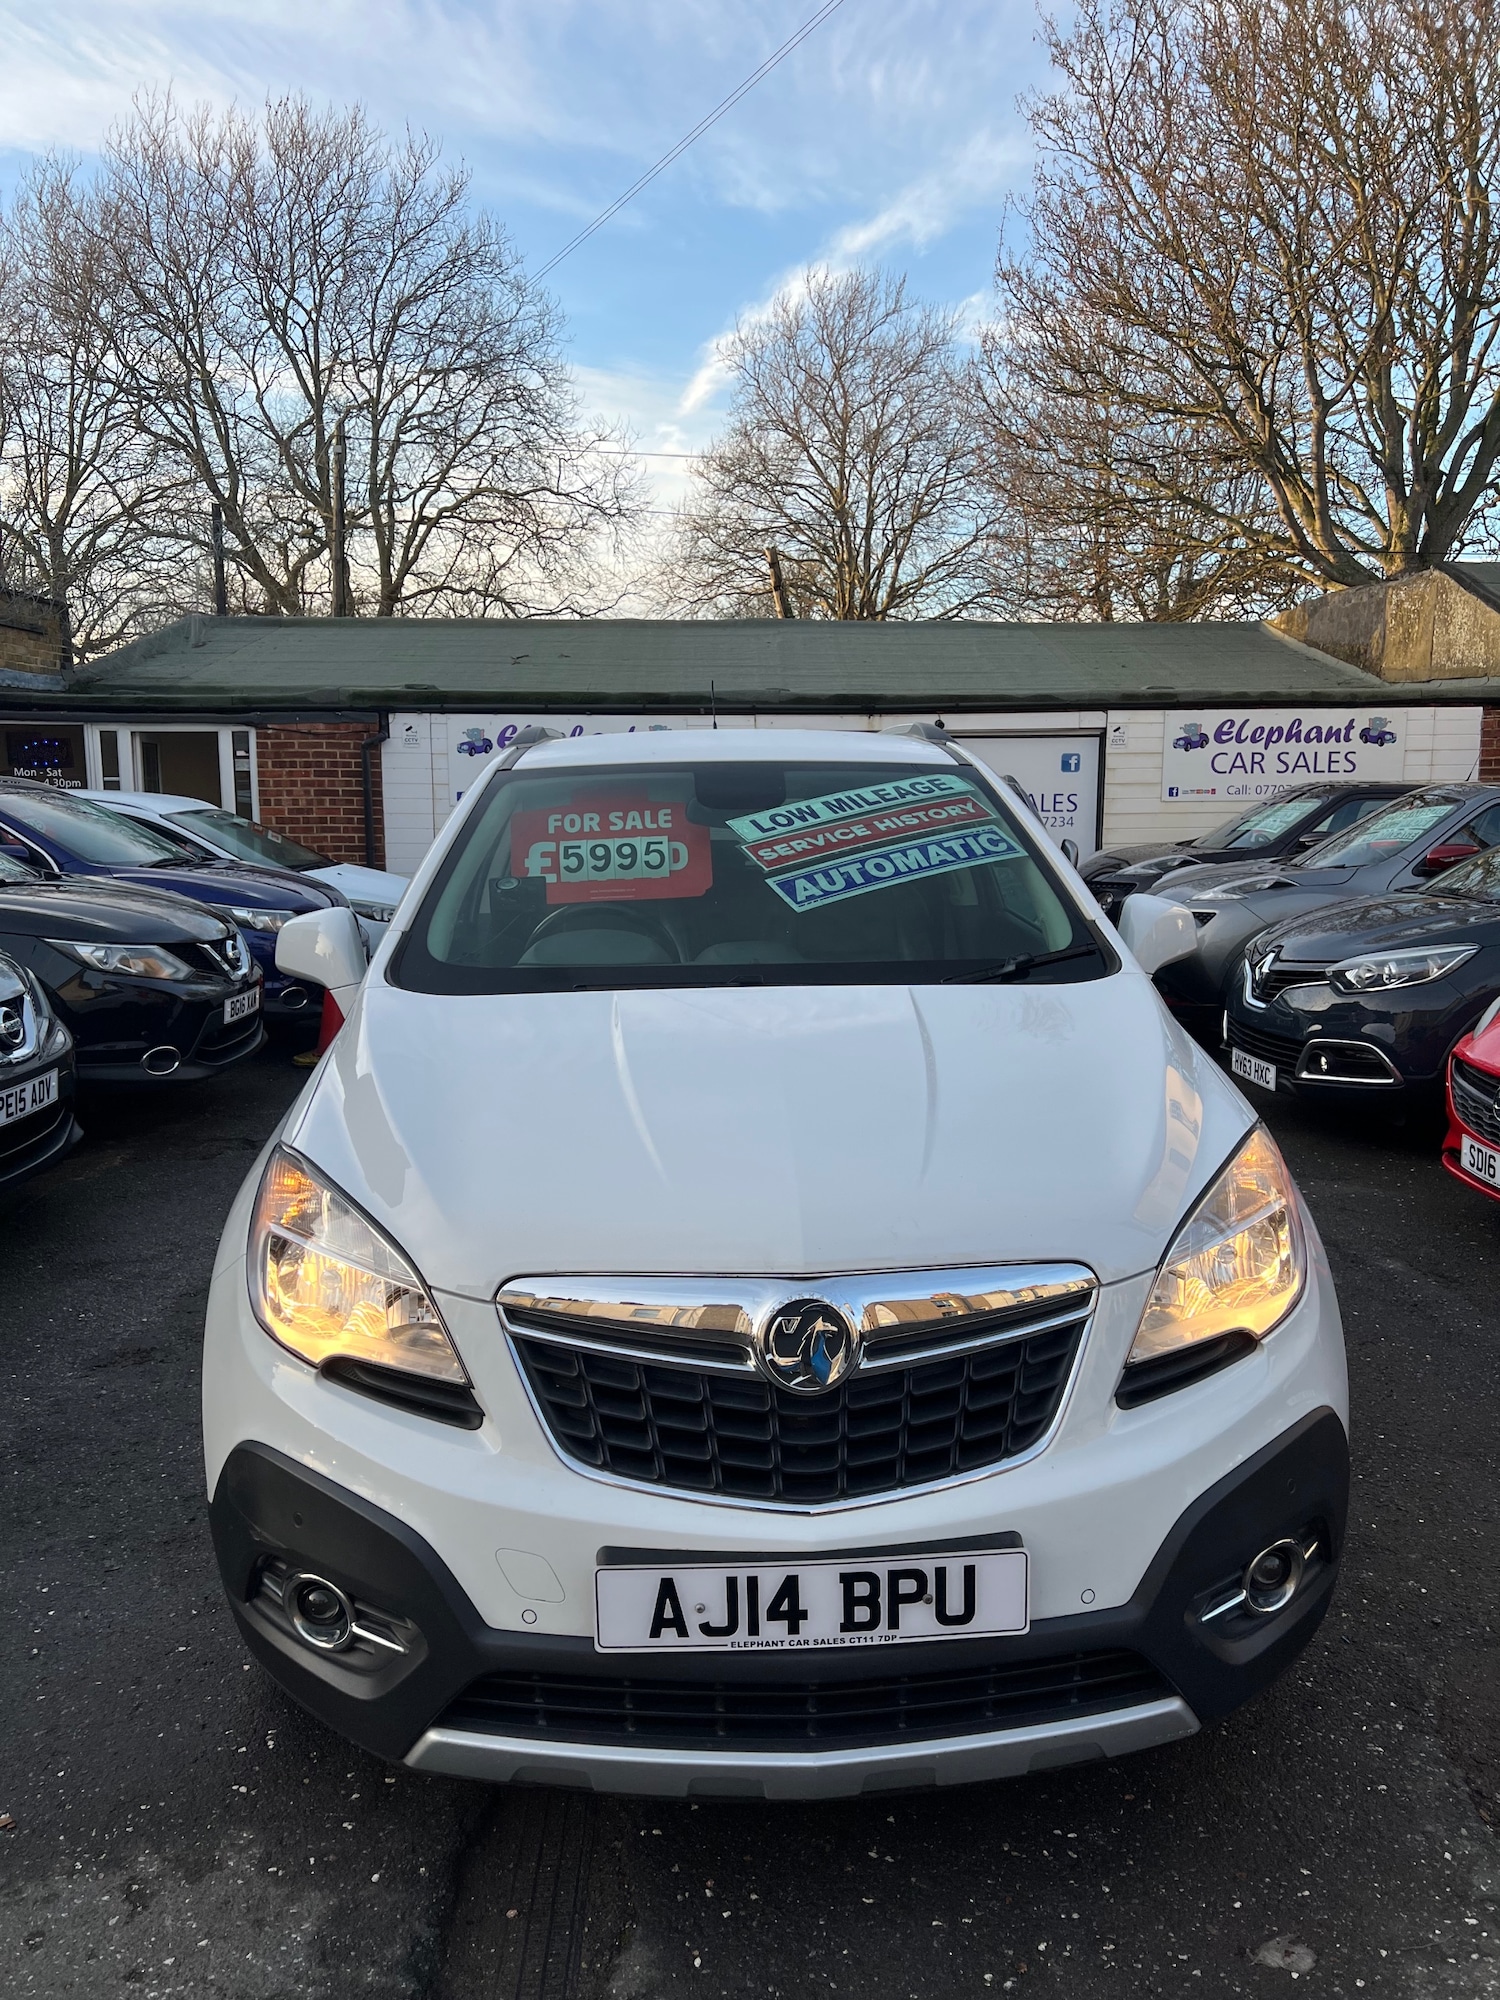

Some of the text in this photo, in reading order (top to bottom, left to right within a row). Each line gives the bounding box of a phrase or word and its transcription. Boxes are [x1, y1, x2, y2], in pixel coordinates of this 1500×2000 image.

[13, 767, 37, 777] Mon
[46, 767, 63, 777] Sat
[1210, 751, 1357, 774] CAR SALES
[1028, 793, 1078, 813] ALES
[1226, 784, 1251, 796] Call:
[749, 777, 954, 834] LOW MILEAGE
[548, 808, 673, 834] FOR SALE
[757, 800, 978, 862] SERVICE HISTORY
[792, 832, 1009, 903] AUTOMATIC
[1253, 1061, 1271, 1085] HXC
[31, 1075, 51, 1108] ADV
[1469, 1144, 1497, 1179] SD16
[648, 1564, 977, 1639] AJ14 BPU
[730, 1634, 897, 1649] ELEPHANT CAR SALES CT11 7DP
